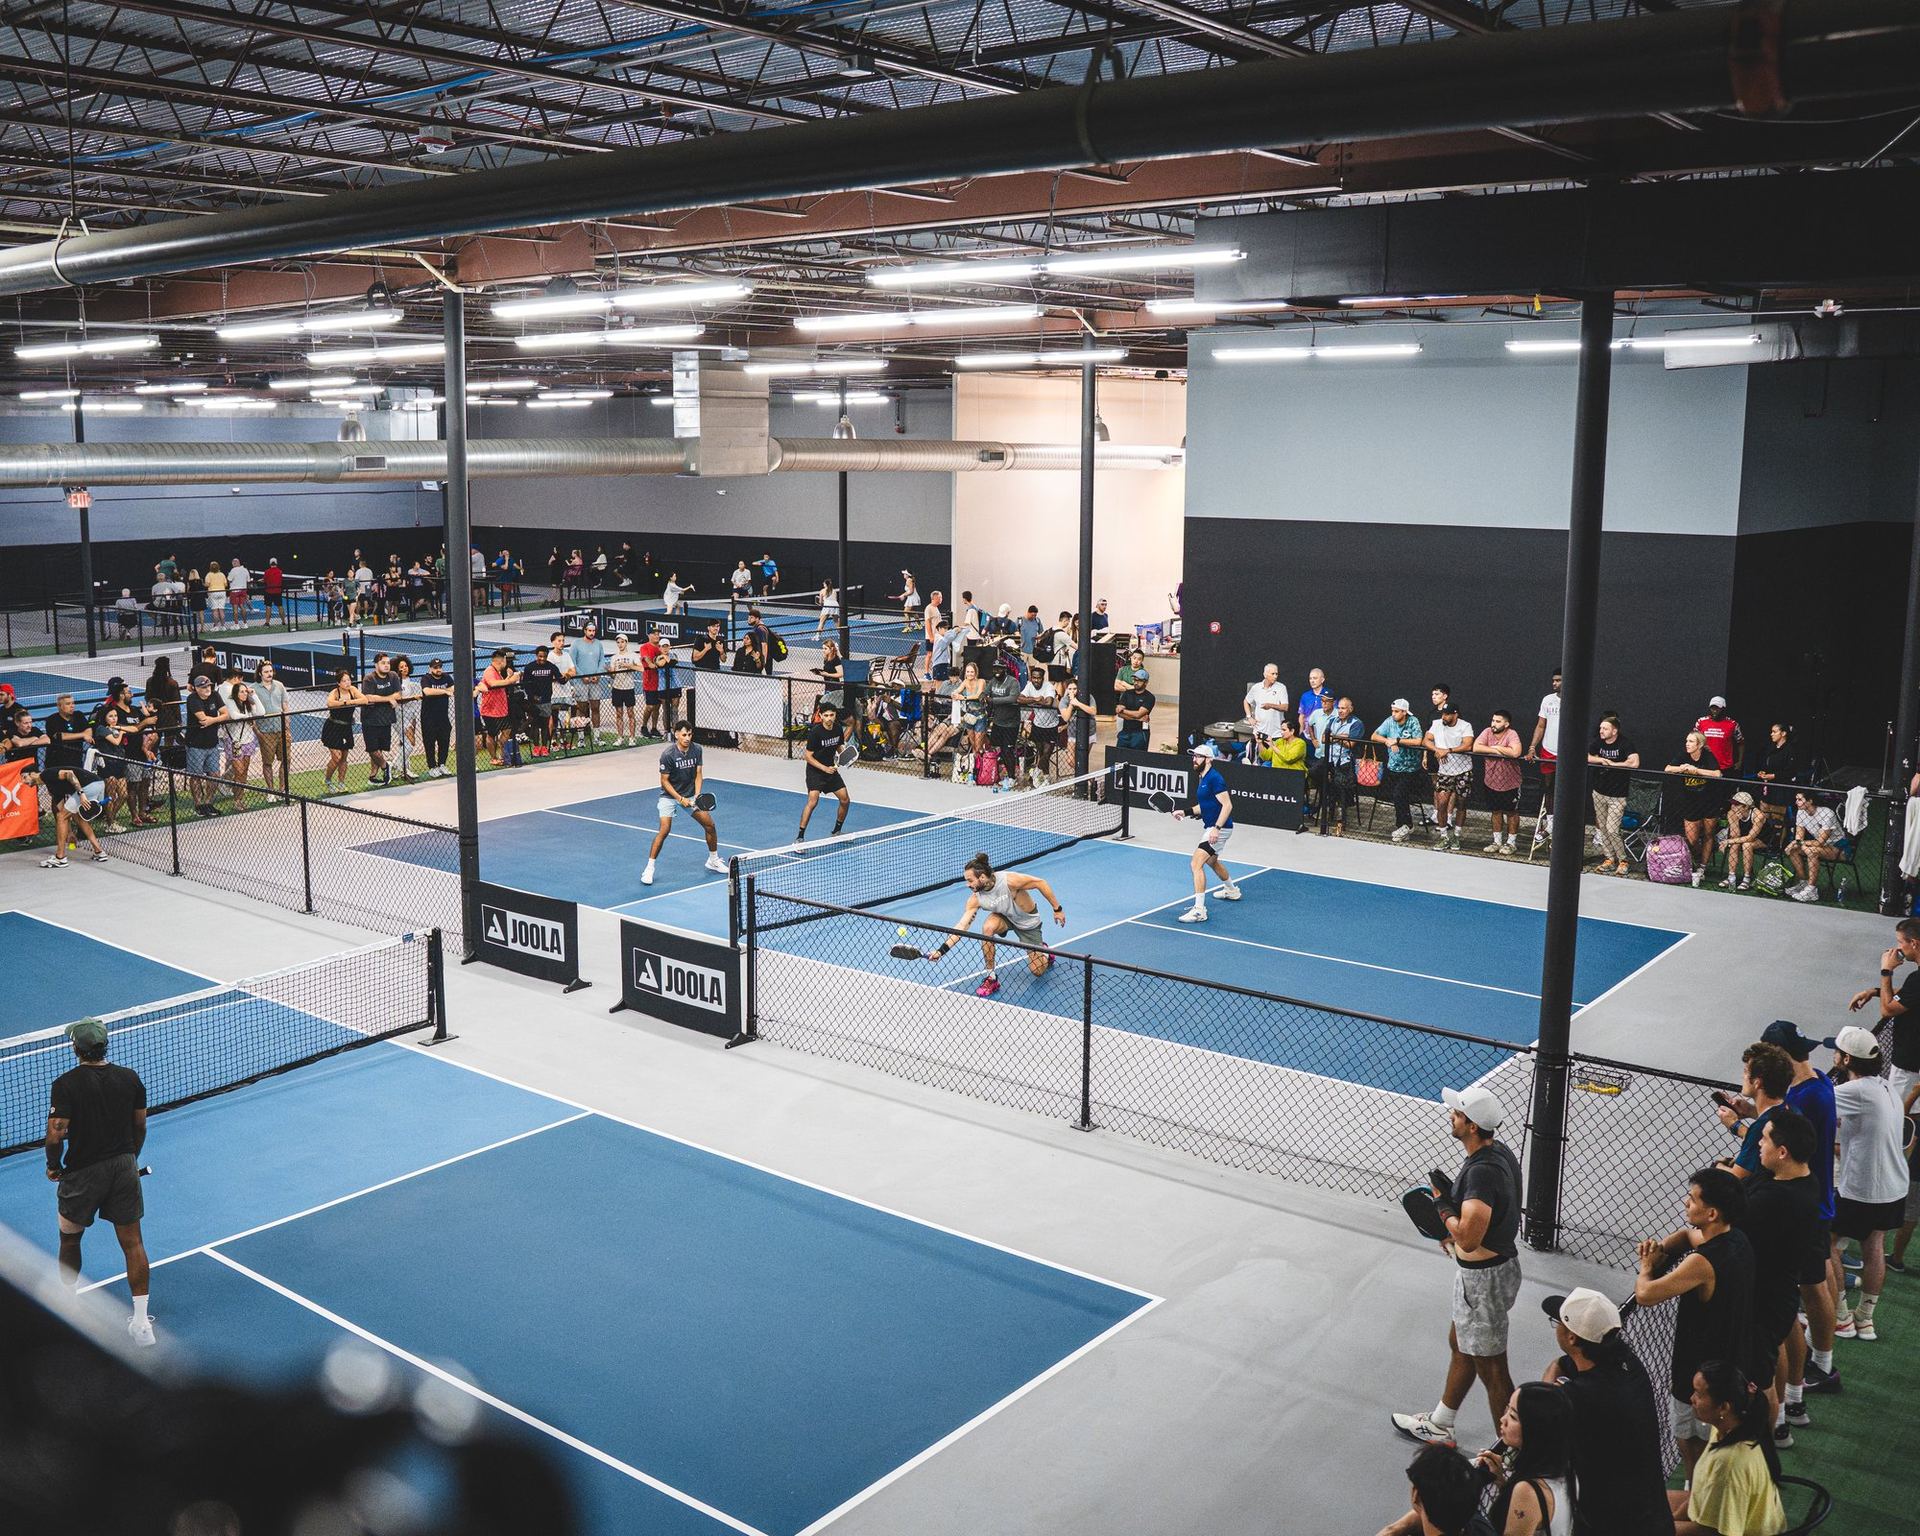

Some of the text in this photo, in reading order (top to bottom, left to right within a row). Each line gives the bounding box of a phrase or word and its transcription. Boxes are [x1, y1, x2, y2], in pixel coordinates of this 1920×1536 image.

[71, 493, 88, 508] EXIT
[617, 620, 637, 632] JOOLA
[282, 664, 309, 673] PICKLEBALL
[1139, 771, 1185, 794] JOOLA
[1231, 788, 1297, 803] PICKLEBALL
[511, 918, 562, 955] JOOLA
[665, 964, 722, 1006] JOOLA
